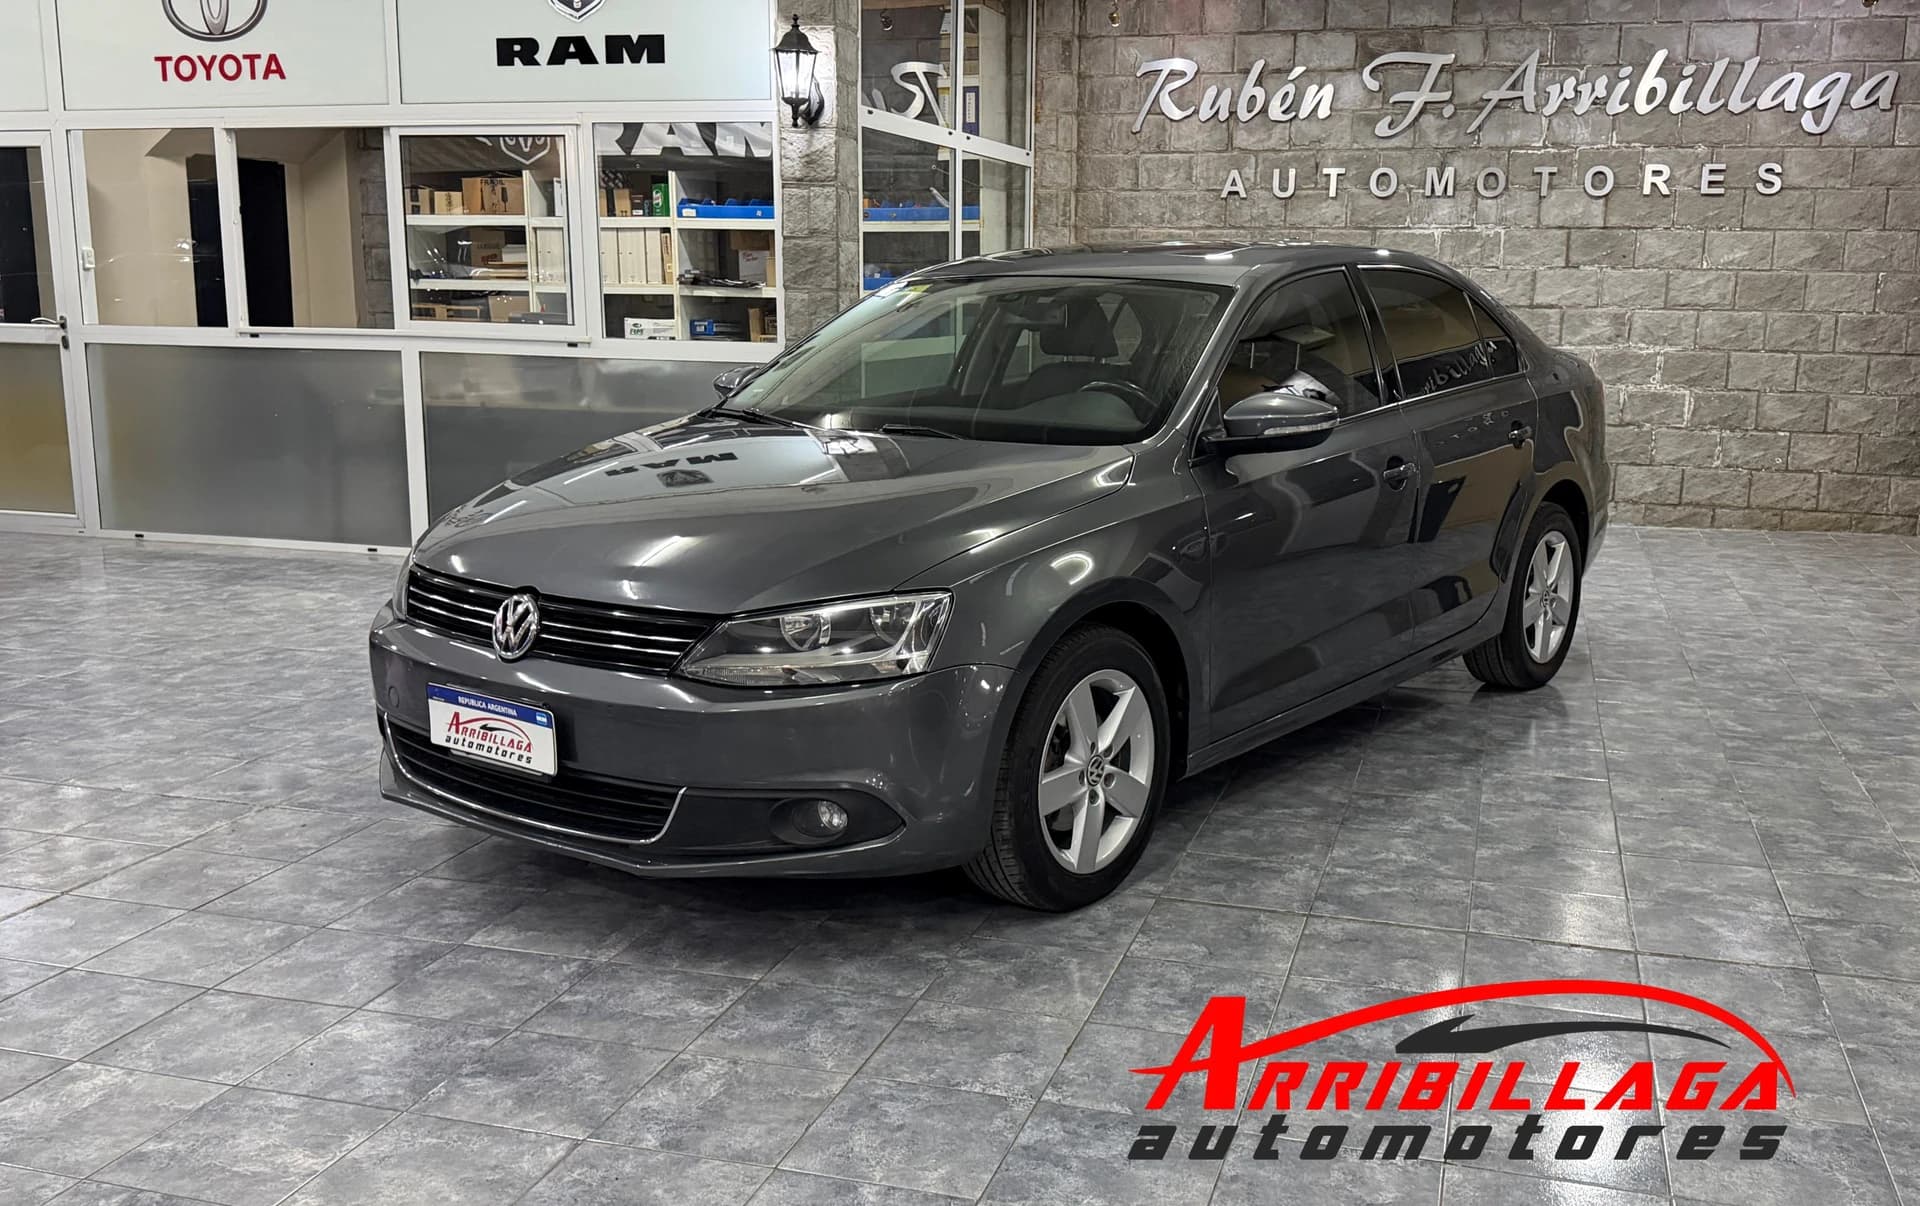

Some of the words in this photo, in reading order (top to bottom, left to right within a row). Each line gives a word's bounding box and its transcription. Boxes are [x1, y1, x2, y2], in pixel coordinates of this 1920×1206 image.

[154, 53, 286, 82] TOYOTA
[496, 34, 665, 67] RAM
[1131, 56, 1335, 135] Rubén
[1466, 47, 1900, 136] Arribillaga
[1220, 161, 1785, 199] AUTOMOTORES
[445, 735, 533, 764] automotores
[447, 711, 533, 753] ARRIBILLAGA
